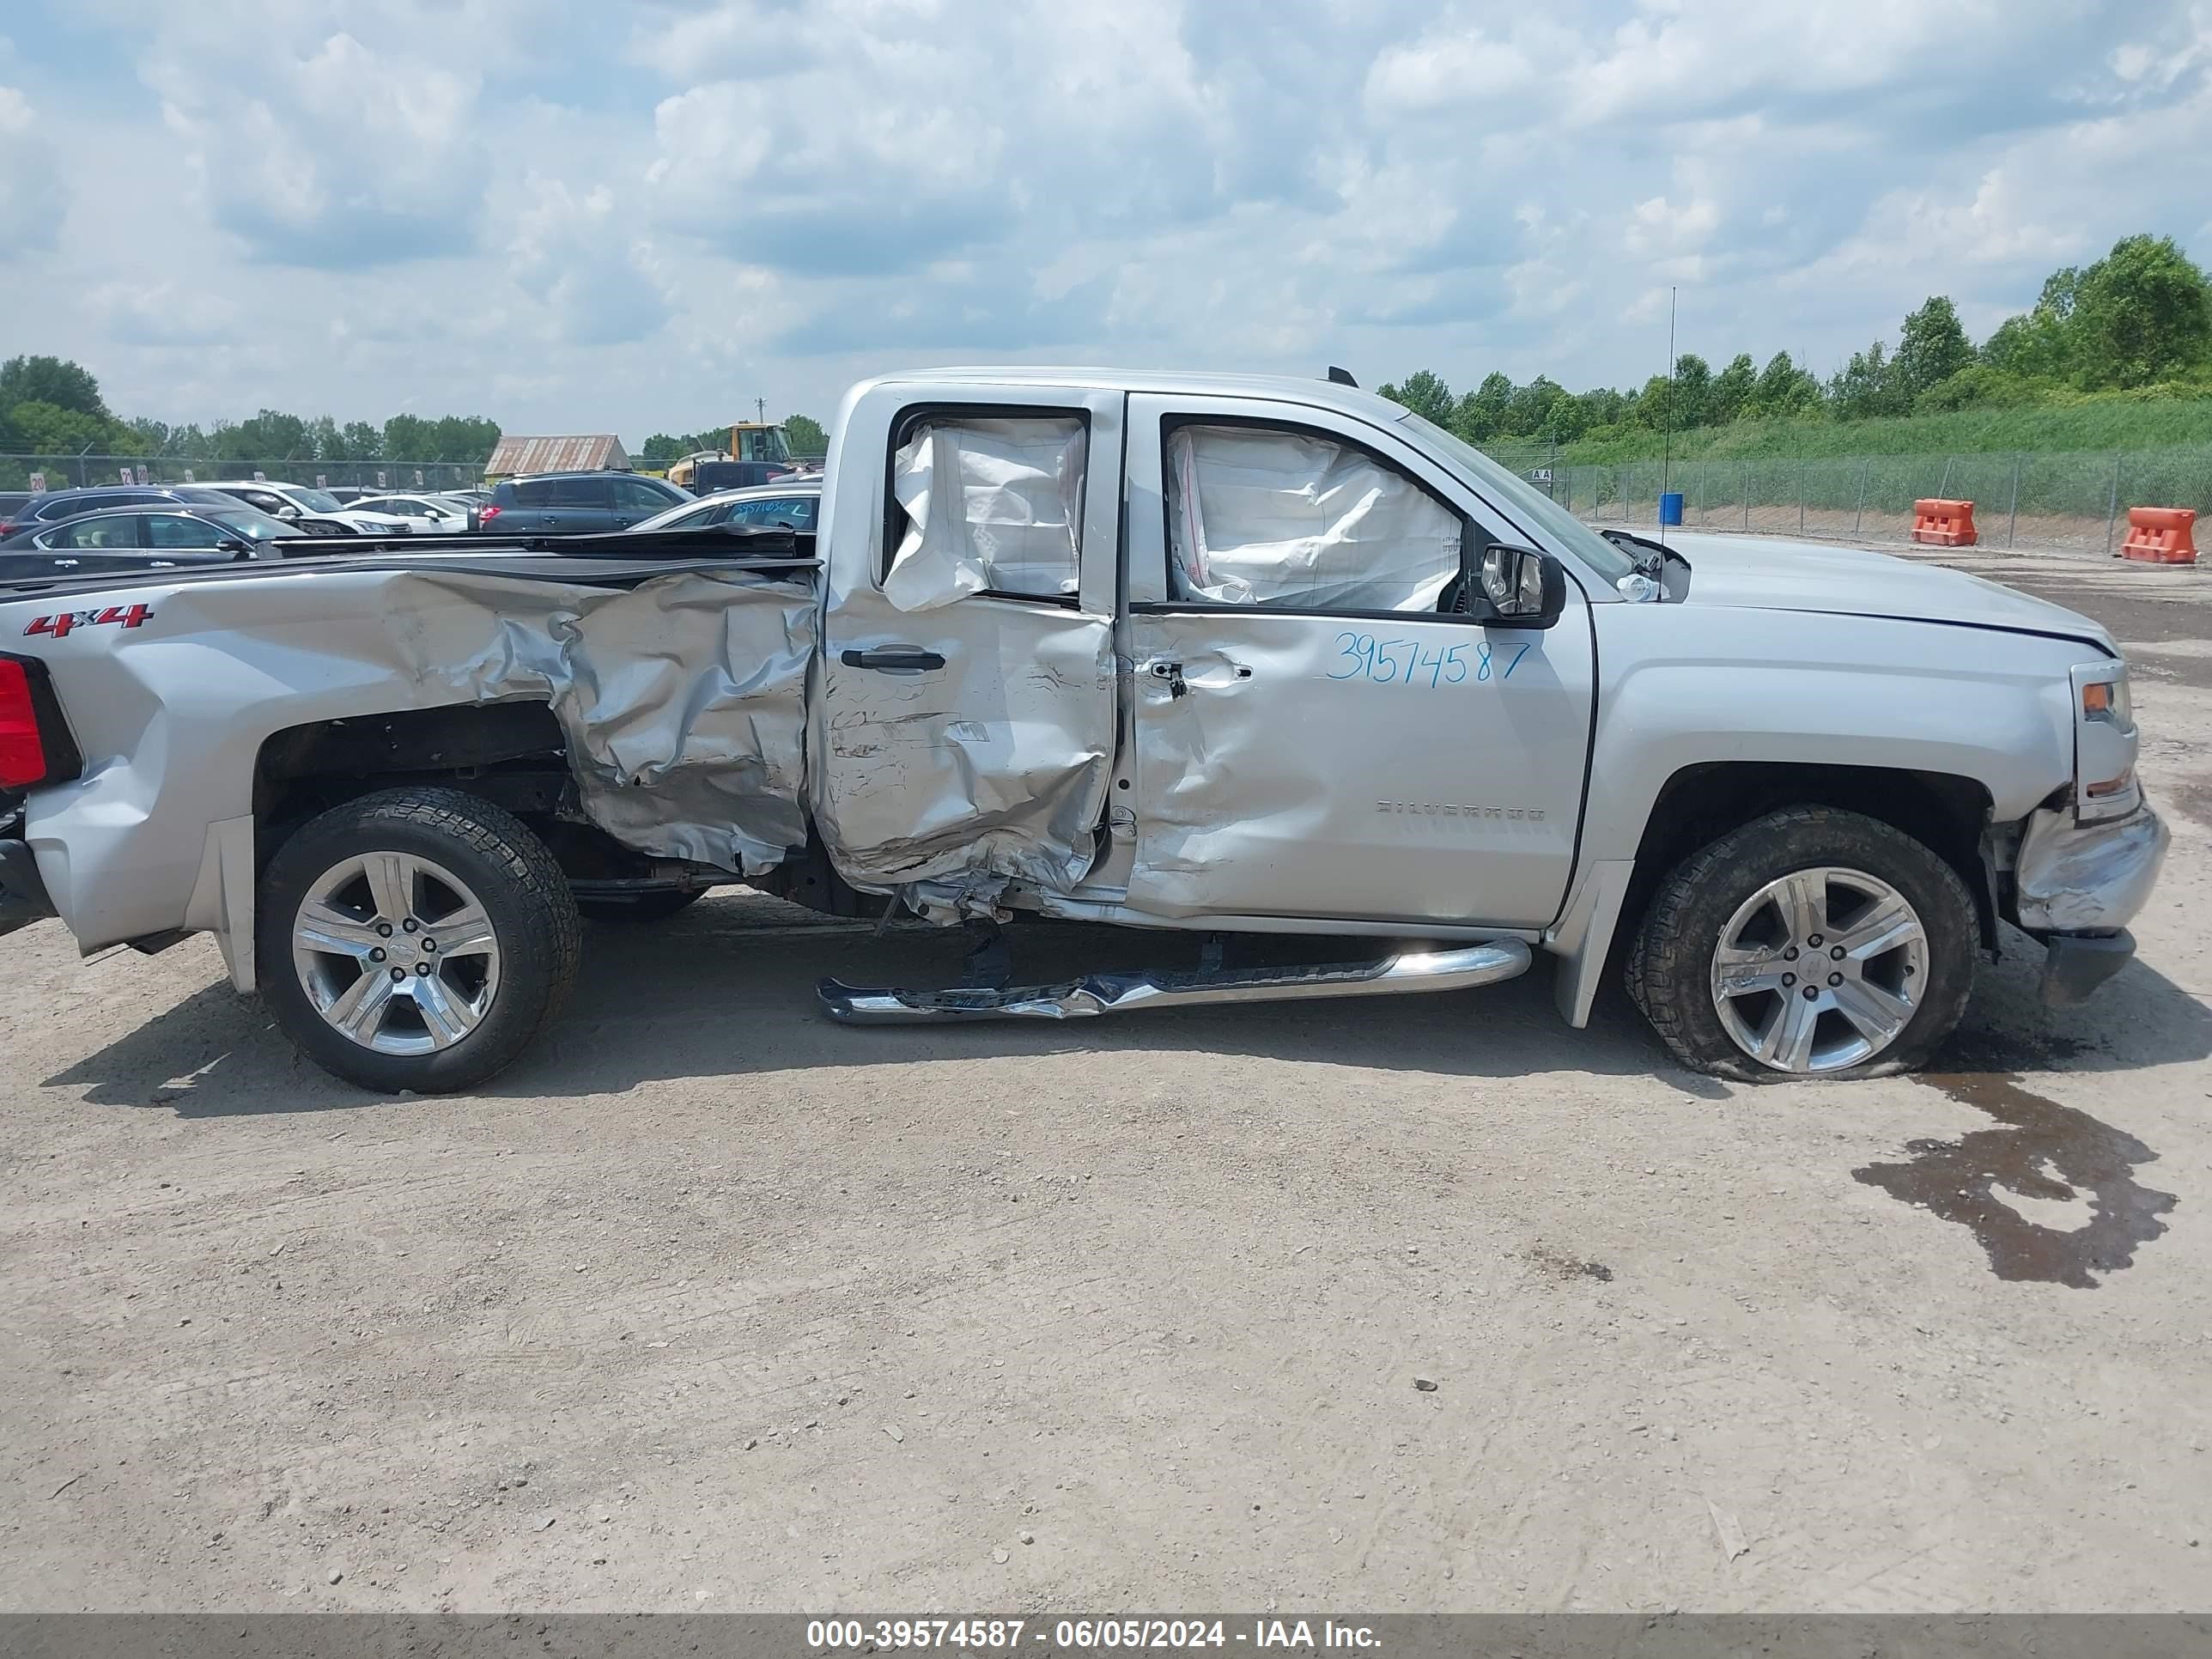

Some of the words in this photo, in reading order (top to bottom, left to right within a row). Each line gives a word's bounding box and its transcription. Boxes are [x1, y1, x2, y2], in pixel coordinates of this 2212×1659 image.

[32, 477, 44, 491] 20
[122, 471, 135, 486] 21
[1326, 632, 1531, 689] 39574587
[1376, 800, 1545, 821] SILVERADO
